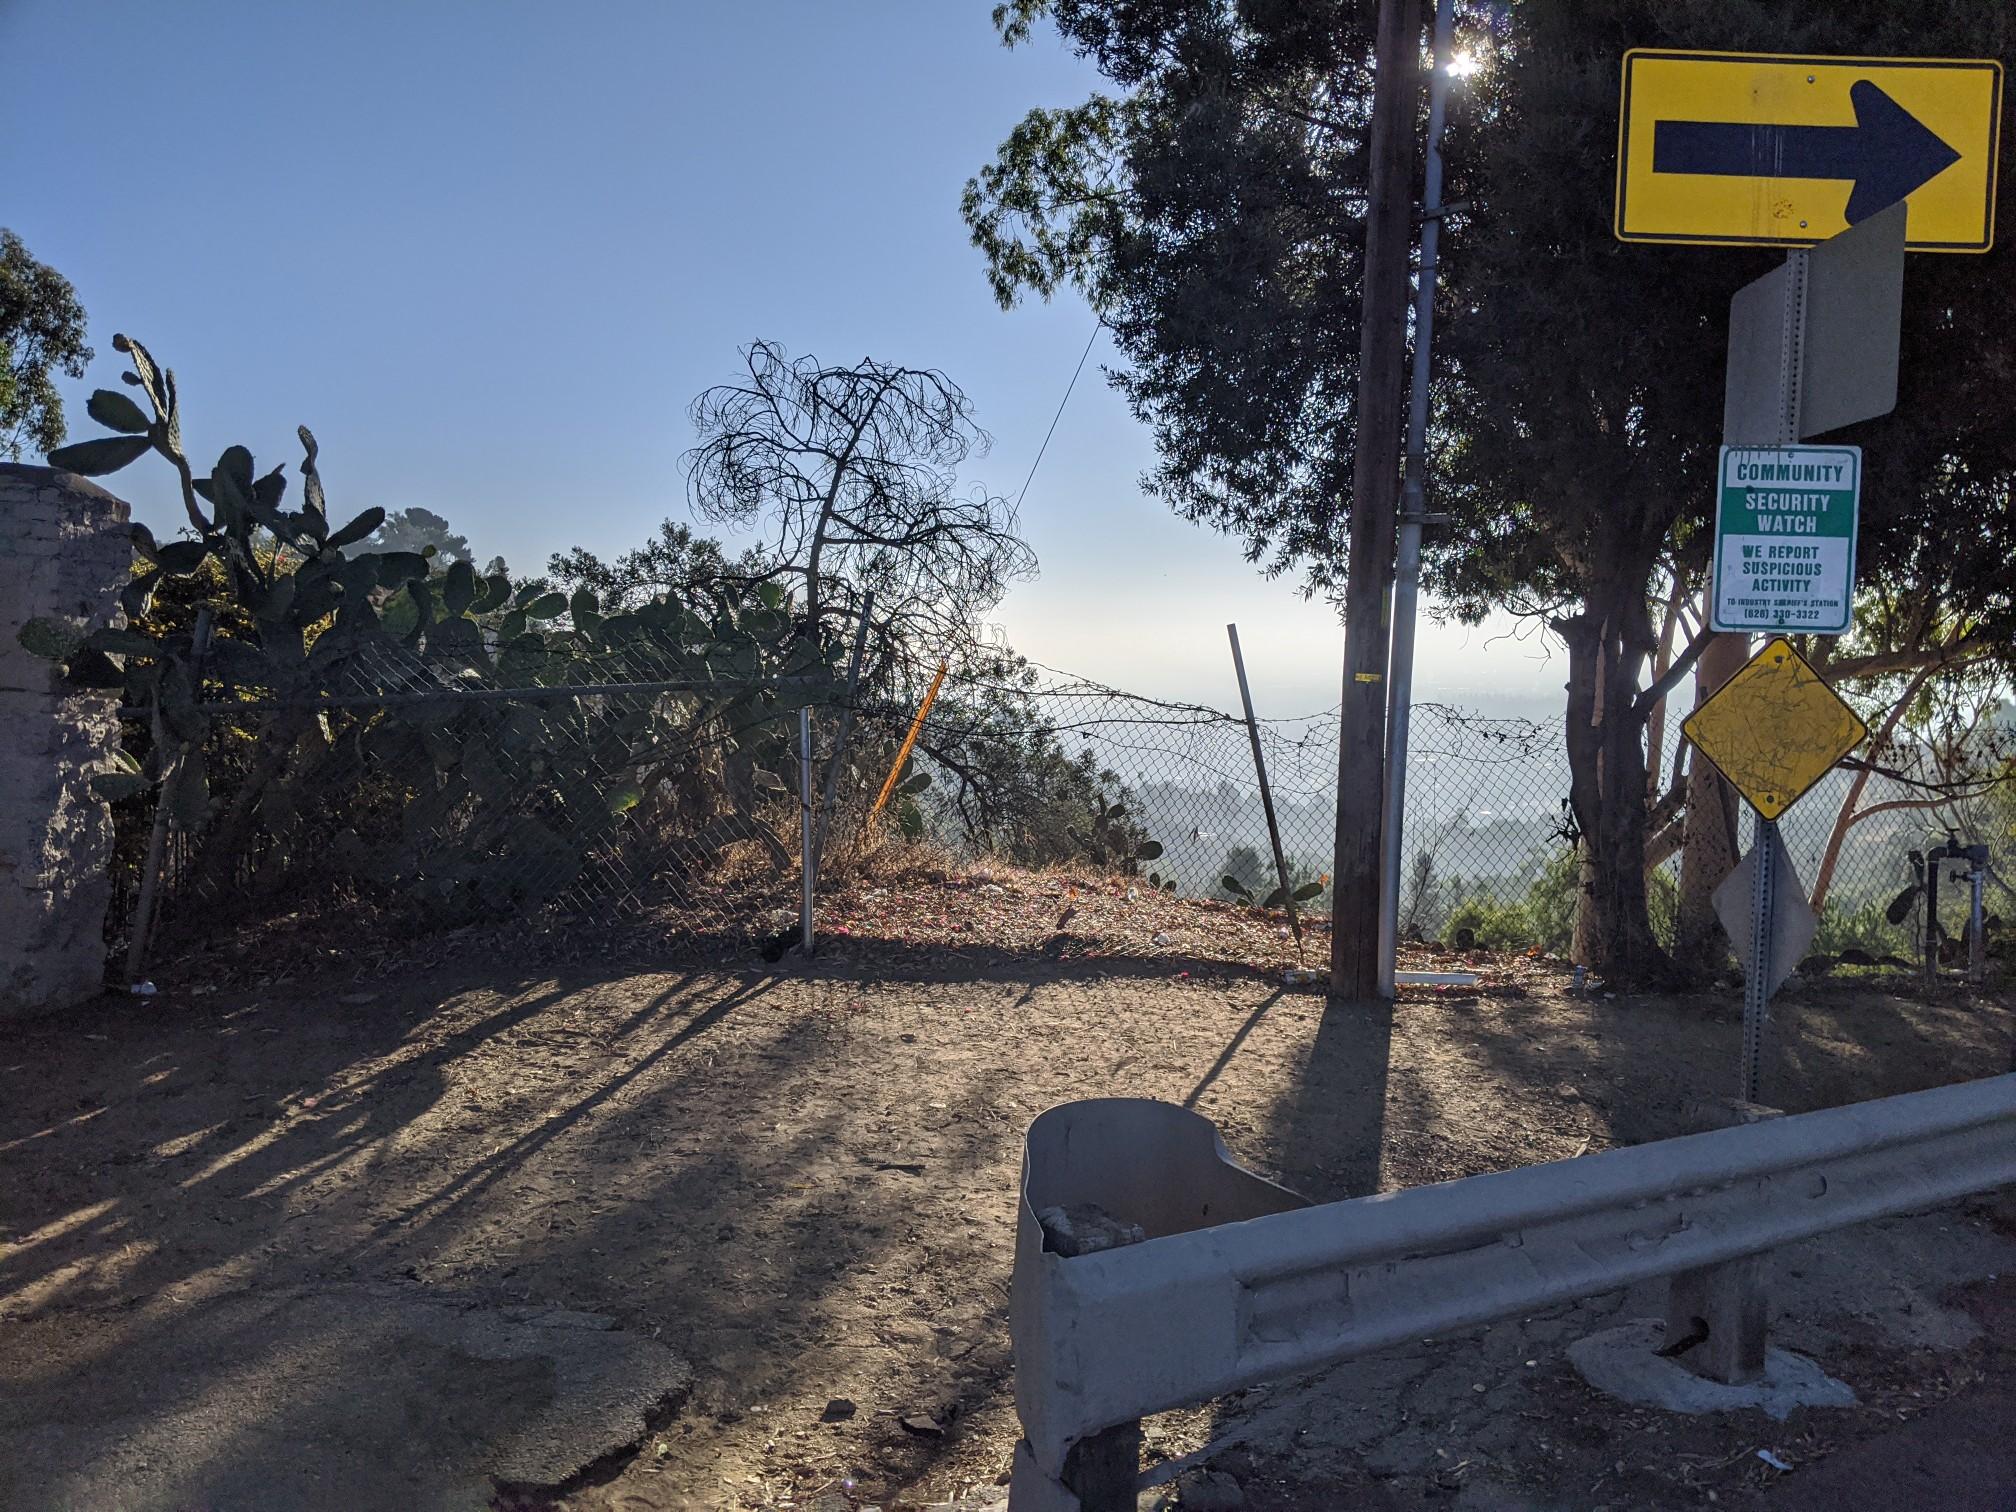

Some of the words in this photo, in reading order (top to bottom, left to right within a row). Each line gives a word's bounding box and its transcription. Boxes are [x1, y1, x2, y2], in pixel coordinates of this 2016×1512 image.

[1737, 463, 1843, 482] COMMUNITY
[1745, 493, 1830, 512] SECURITY
[1758, 515, 1817, 533] WATCH
[1742, 545, 1762, 558] WE
[1769, 546, 1819, 559] REPORT
[1742, 561, 1822, 576] SUSPICIOUS
[1752, 579, 1811, 592] ACTIVITY
[1727, 598, 1736, 606] TO
[1738, 599, 1771, 607] INDUSTRY
[1810, 600, 1839, 608] STATION
[1772, 609, 1820, 620] 330-3322
